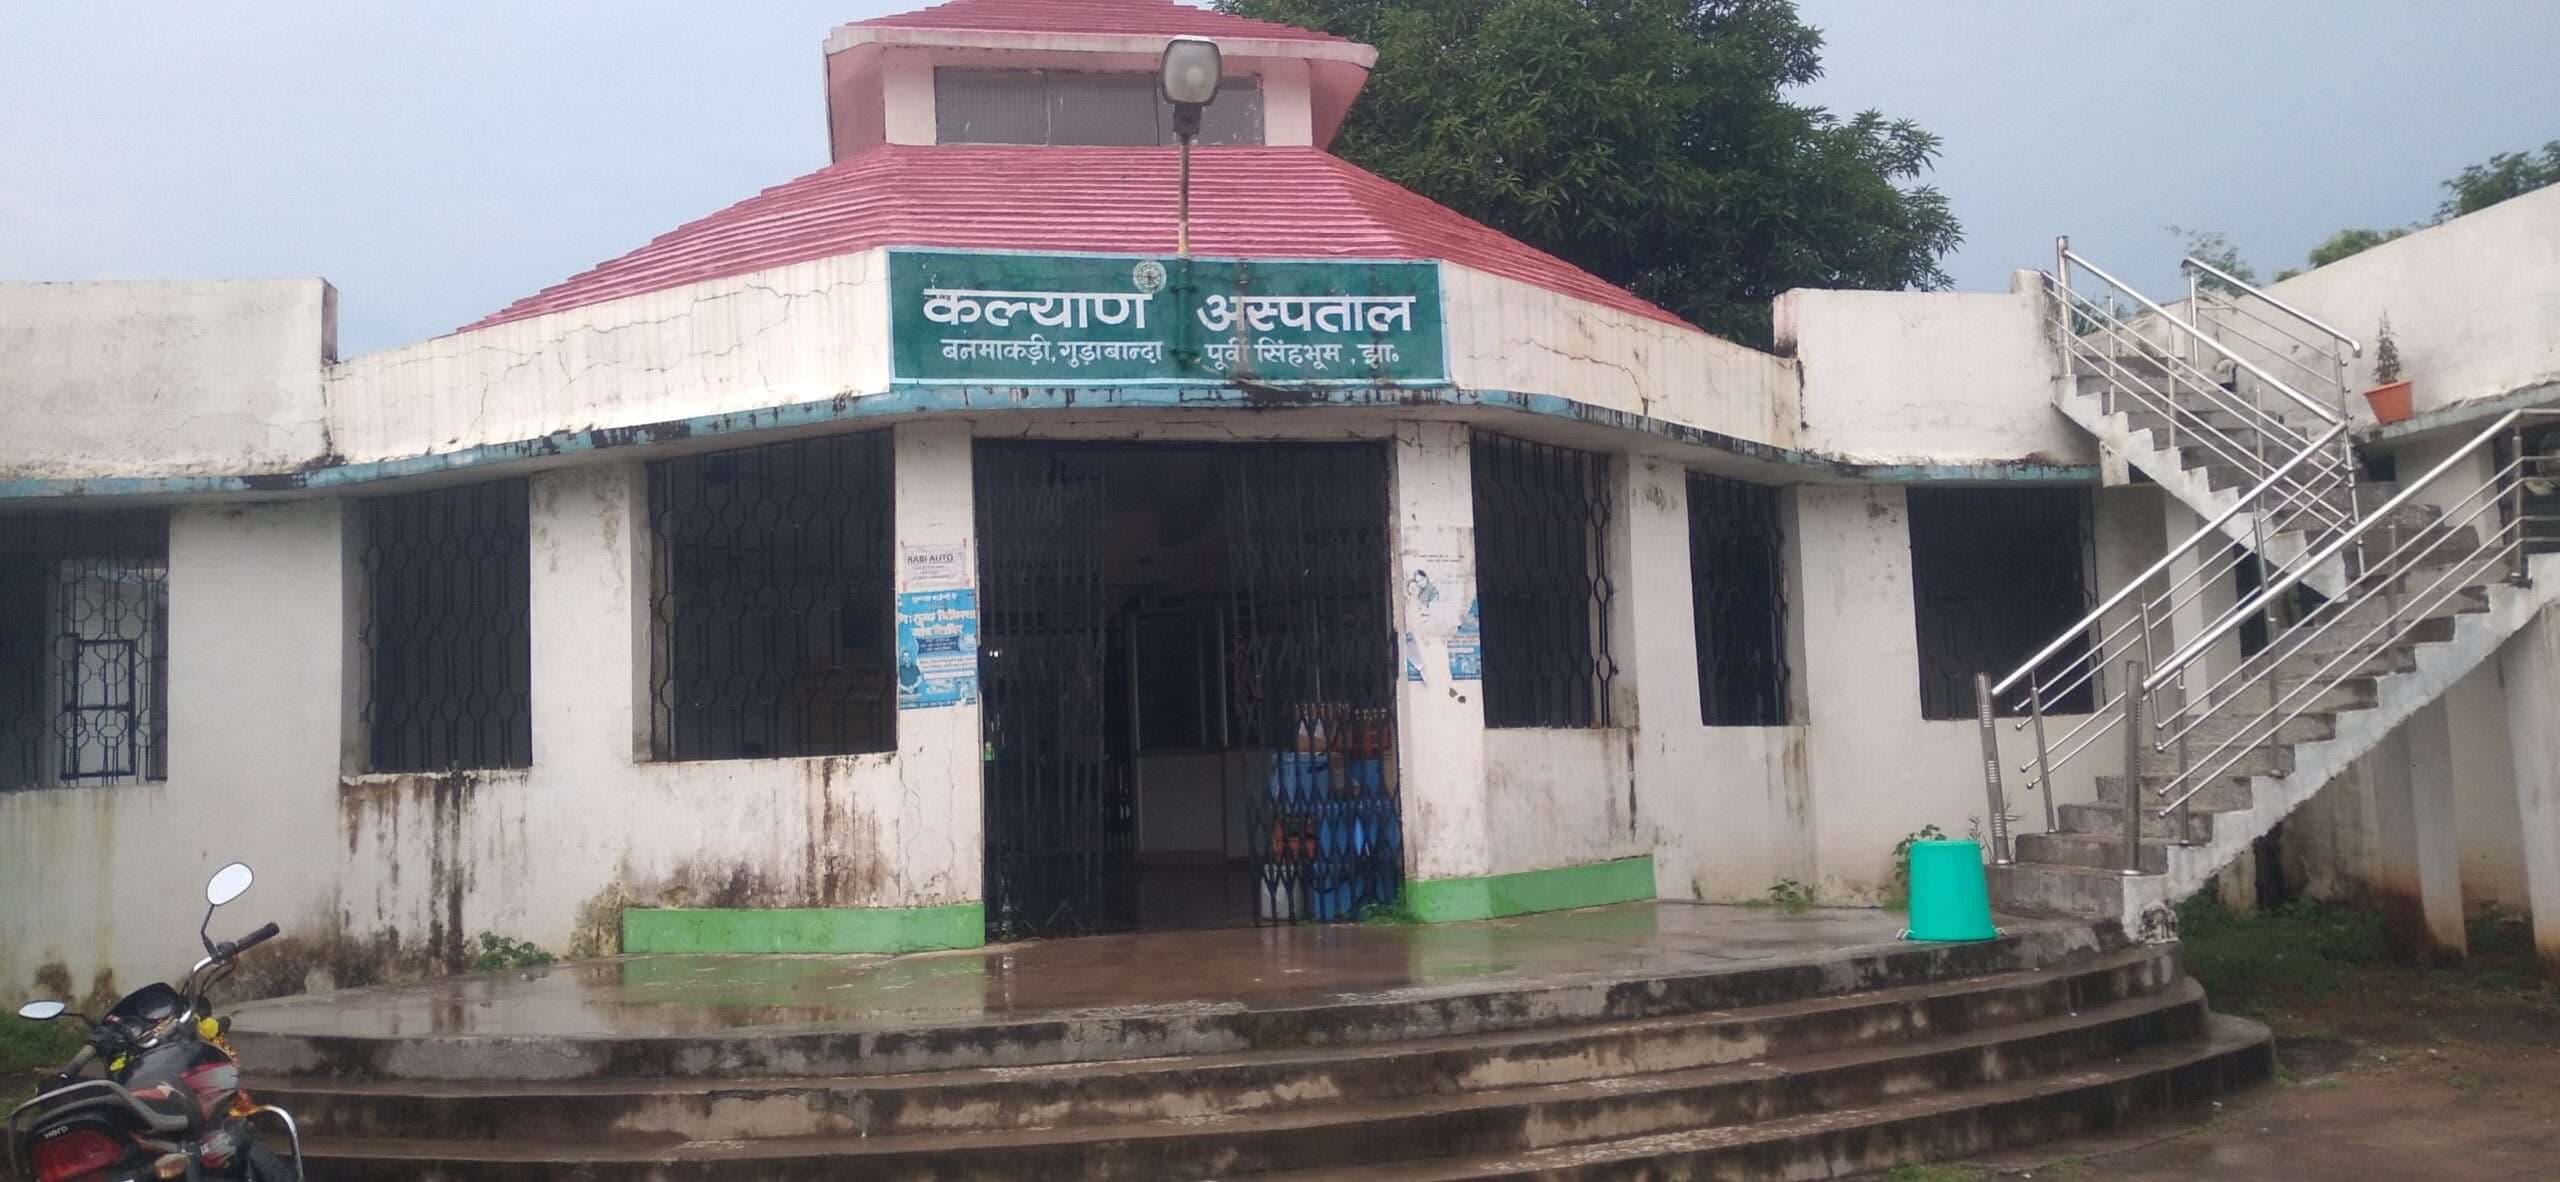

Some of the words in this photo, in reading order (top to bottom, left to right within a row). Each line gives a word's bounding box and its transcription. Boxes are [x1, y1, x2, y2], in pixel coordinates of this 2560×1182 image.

[923, 288, 1153, 329] कल्याण
[1196, 294, 1416, 334] अस्पताल
[928, 553, 954, 562] AUTO
